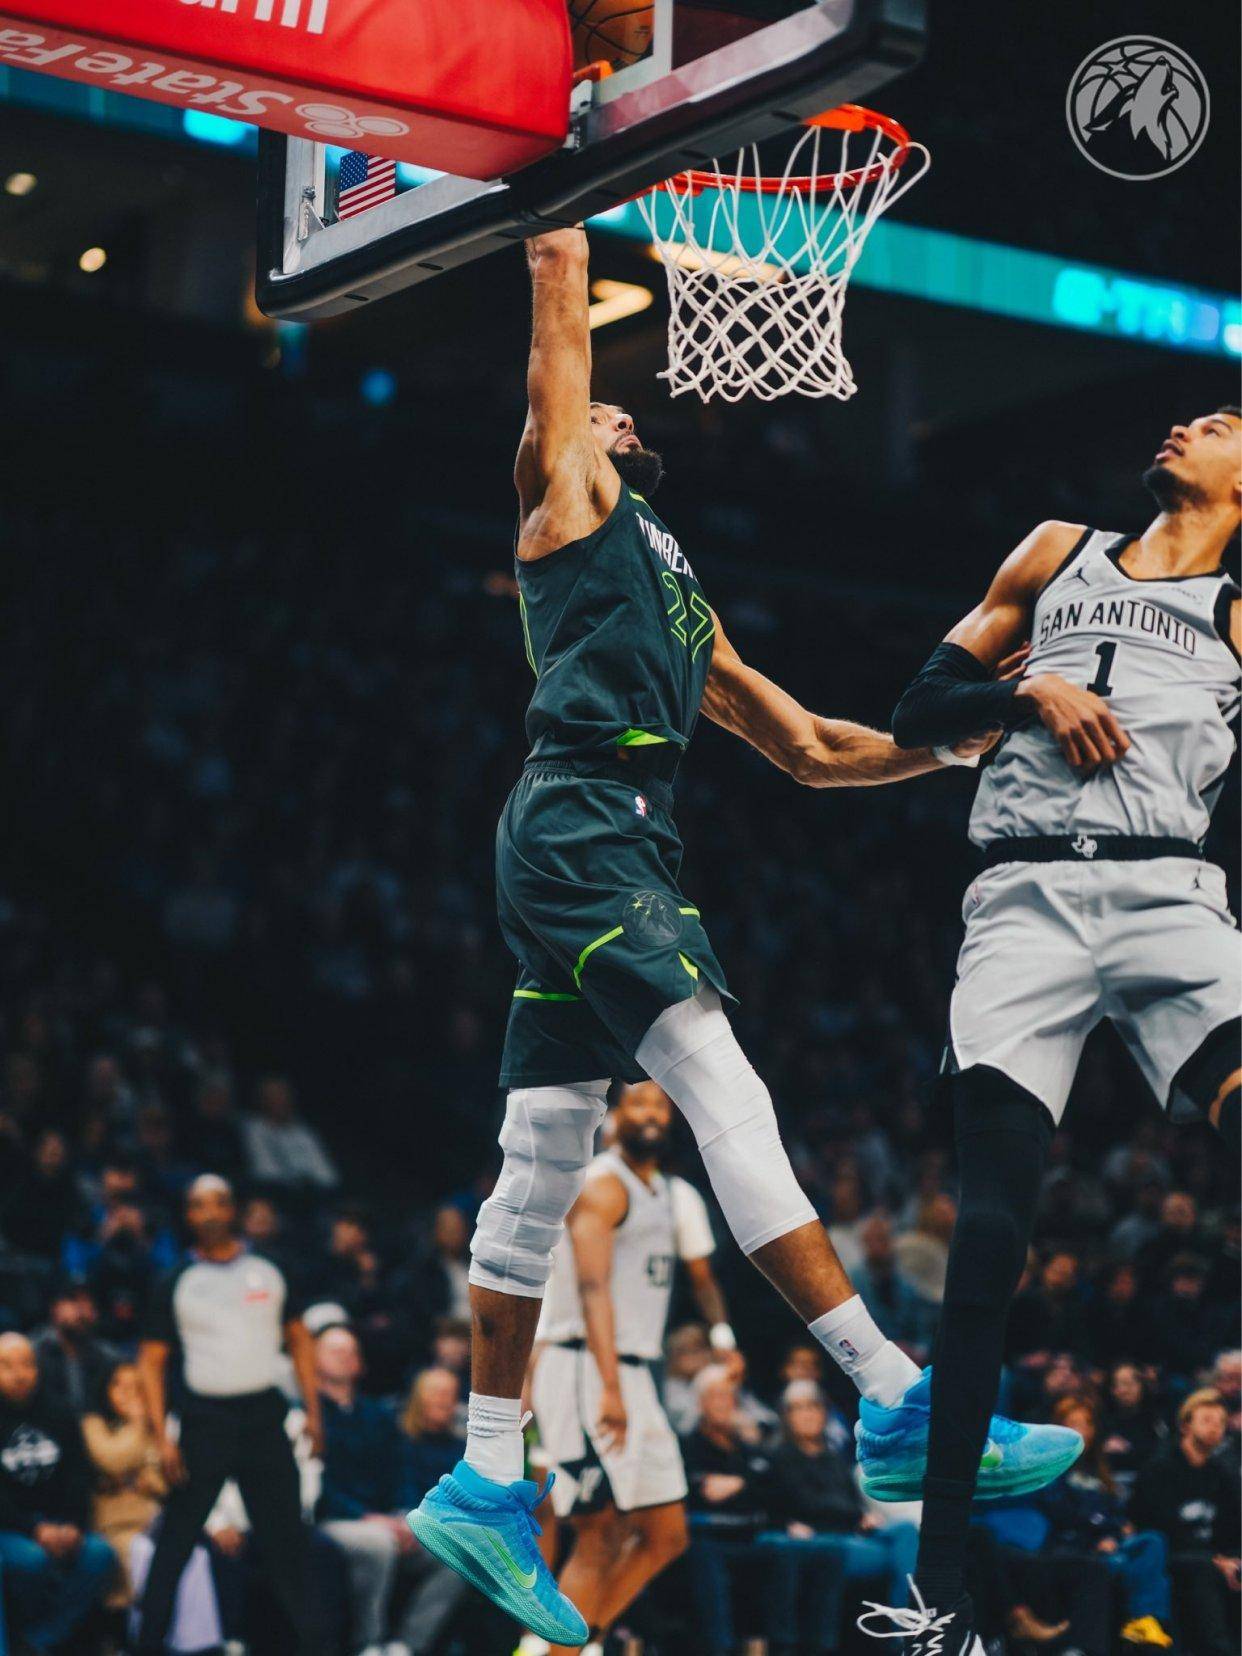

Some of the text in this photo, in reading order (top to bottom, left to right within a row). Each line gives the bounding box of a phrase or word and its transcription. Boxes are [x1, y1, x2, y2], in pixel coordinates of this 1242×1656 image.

[662, 571, 715, 664] 27
[1040, 600, 1196, 655] SAN ANTONIO
[1087, 641, 1117, 697] 1
